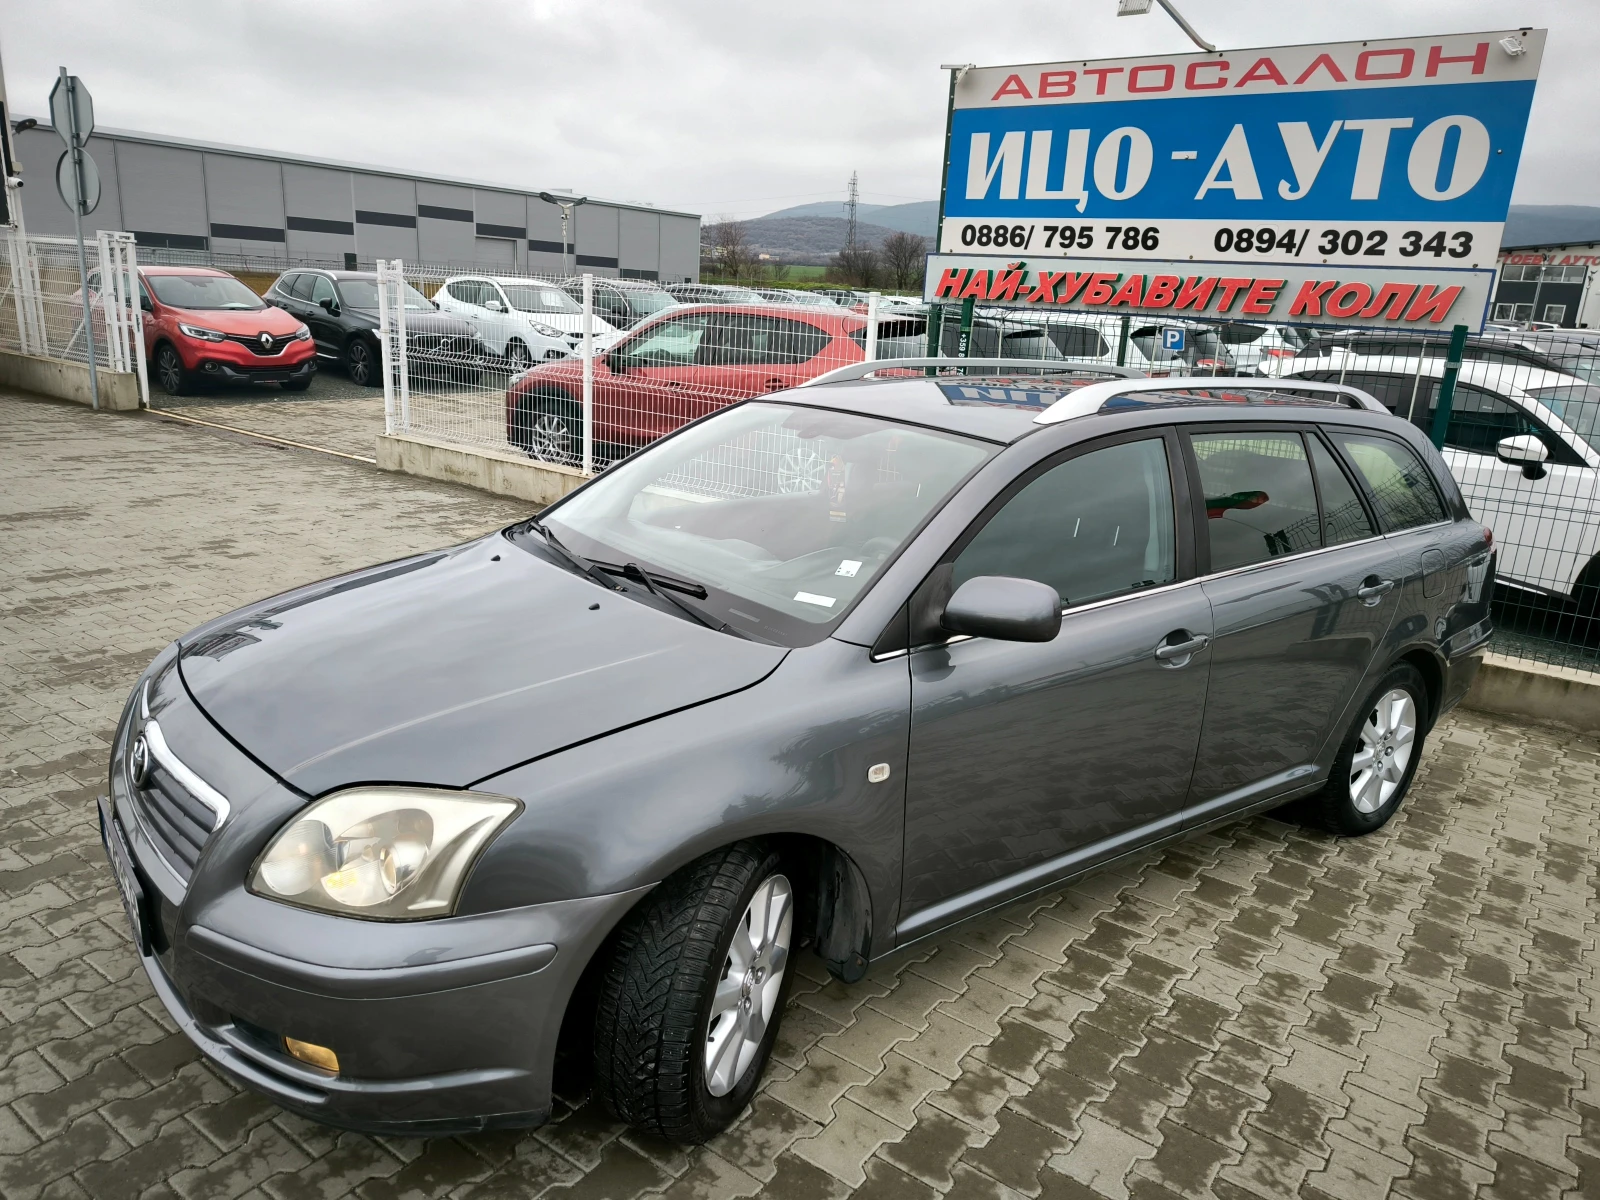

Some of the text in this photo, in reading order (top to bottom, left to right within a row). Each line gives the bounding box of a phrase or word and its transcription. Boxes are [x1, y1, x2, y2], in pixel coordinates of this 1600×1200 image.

[991, 42, 1490, 101] АВТОСАЛОН
[965, 126, 1154, 214] ИЦО
[961, 224, 1160, 251] 0886/ 795 786
[1214, 227, 1474, 258] 0894/ 302 343
[934, 261, 1465, 323] НАЙ-ХУБАВИТЕ КОЛИ
[1166, 330, 1180, 348] P
